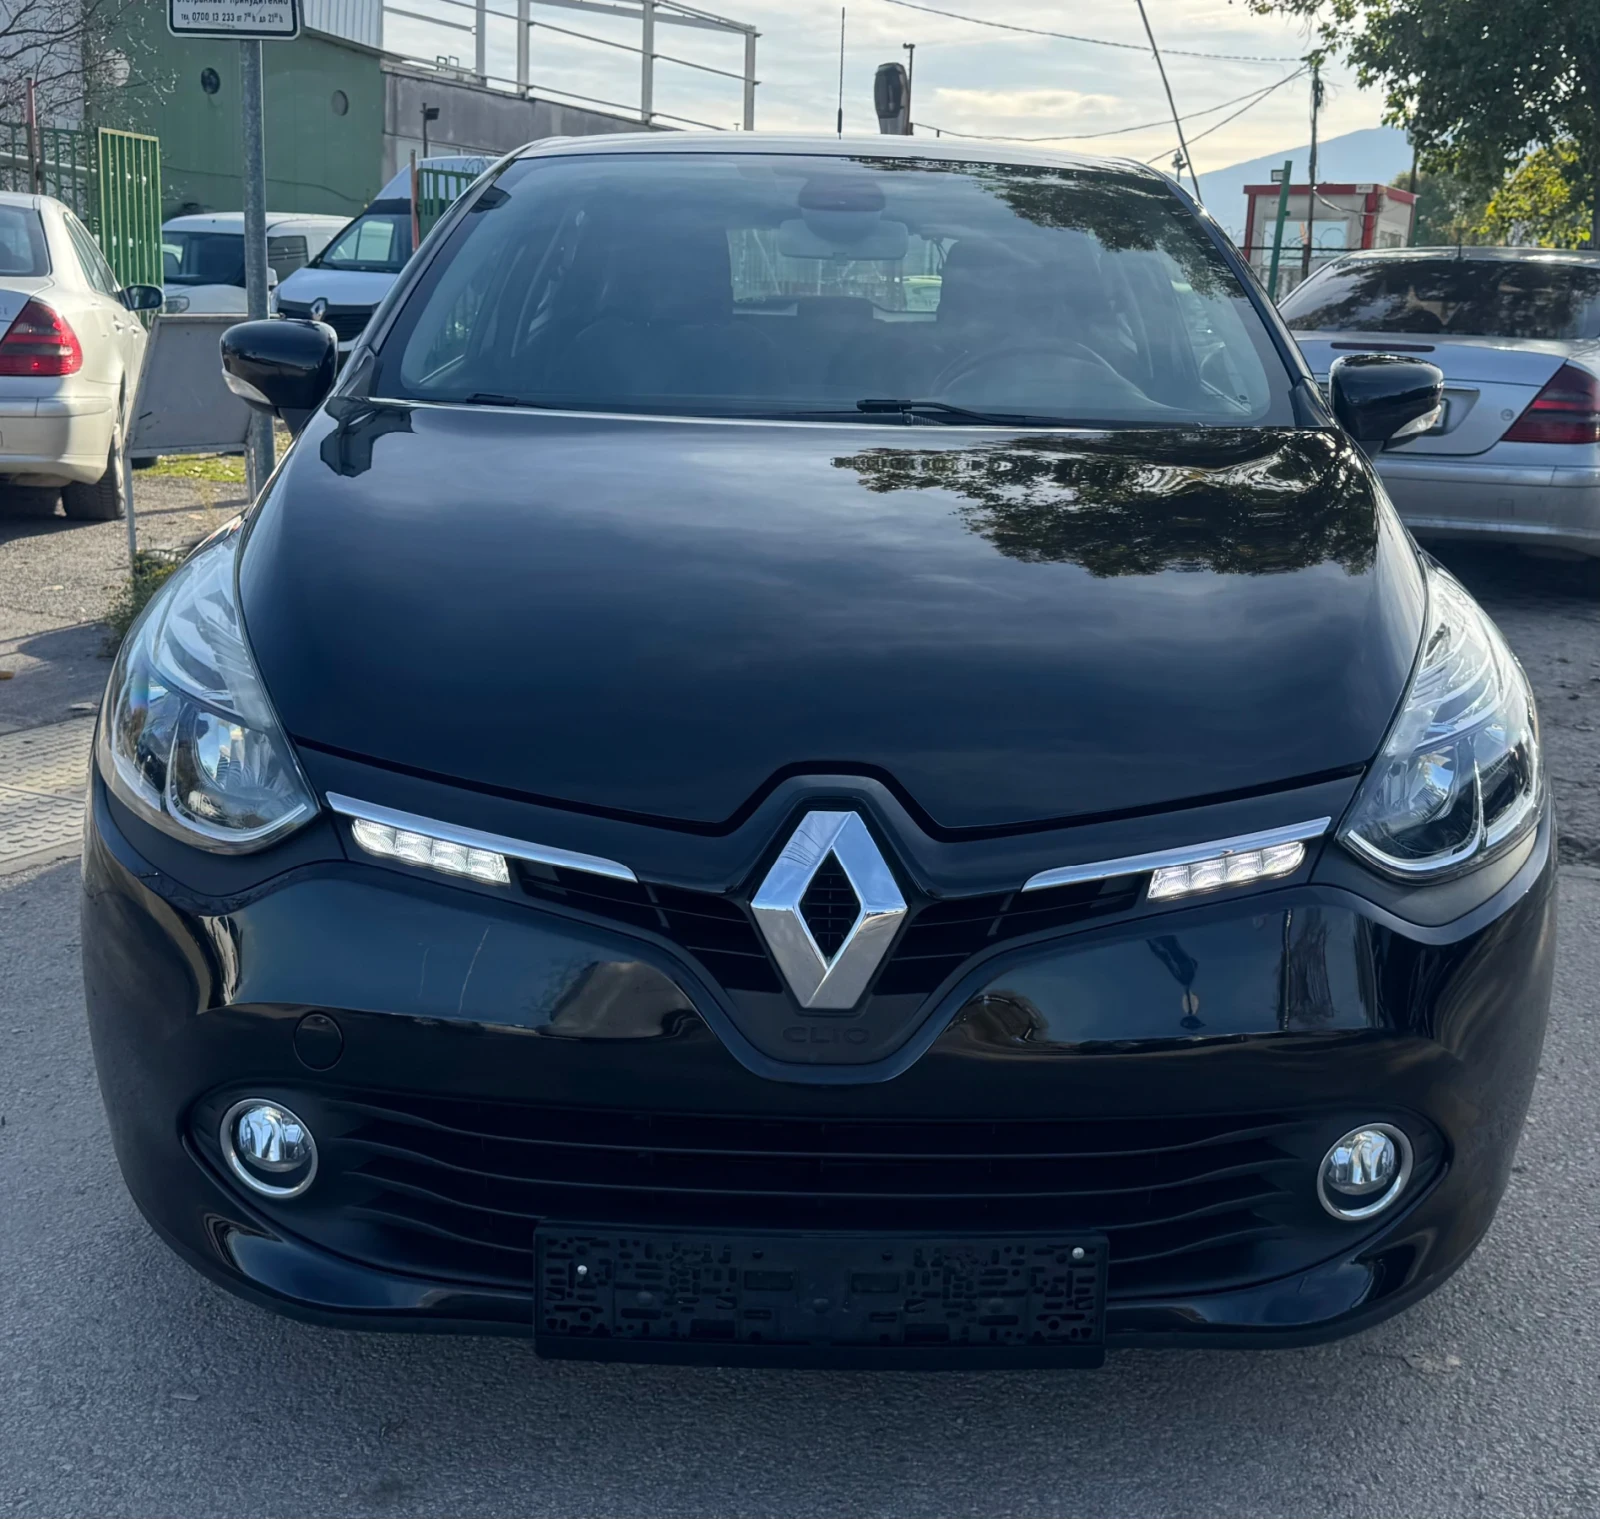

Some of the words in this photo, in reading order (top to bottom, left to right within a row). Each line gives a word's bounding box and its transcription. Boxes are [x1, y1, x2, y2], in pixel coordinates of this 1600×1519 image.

[192, 12, 210, 21] 0700
[212, 12, 219, 21] 13
[222, 12, 235, 22] 233
[782, 1025, 870, 1045] CLIO
